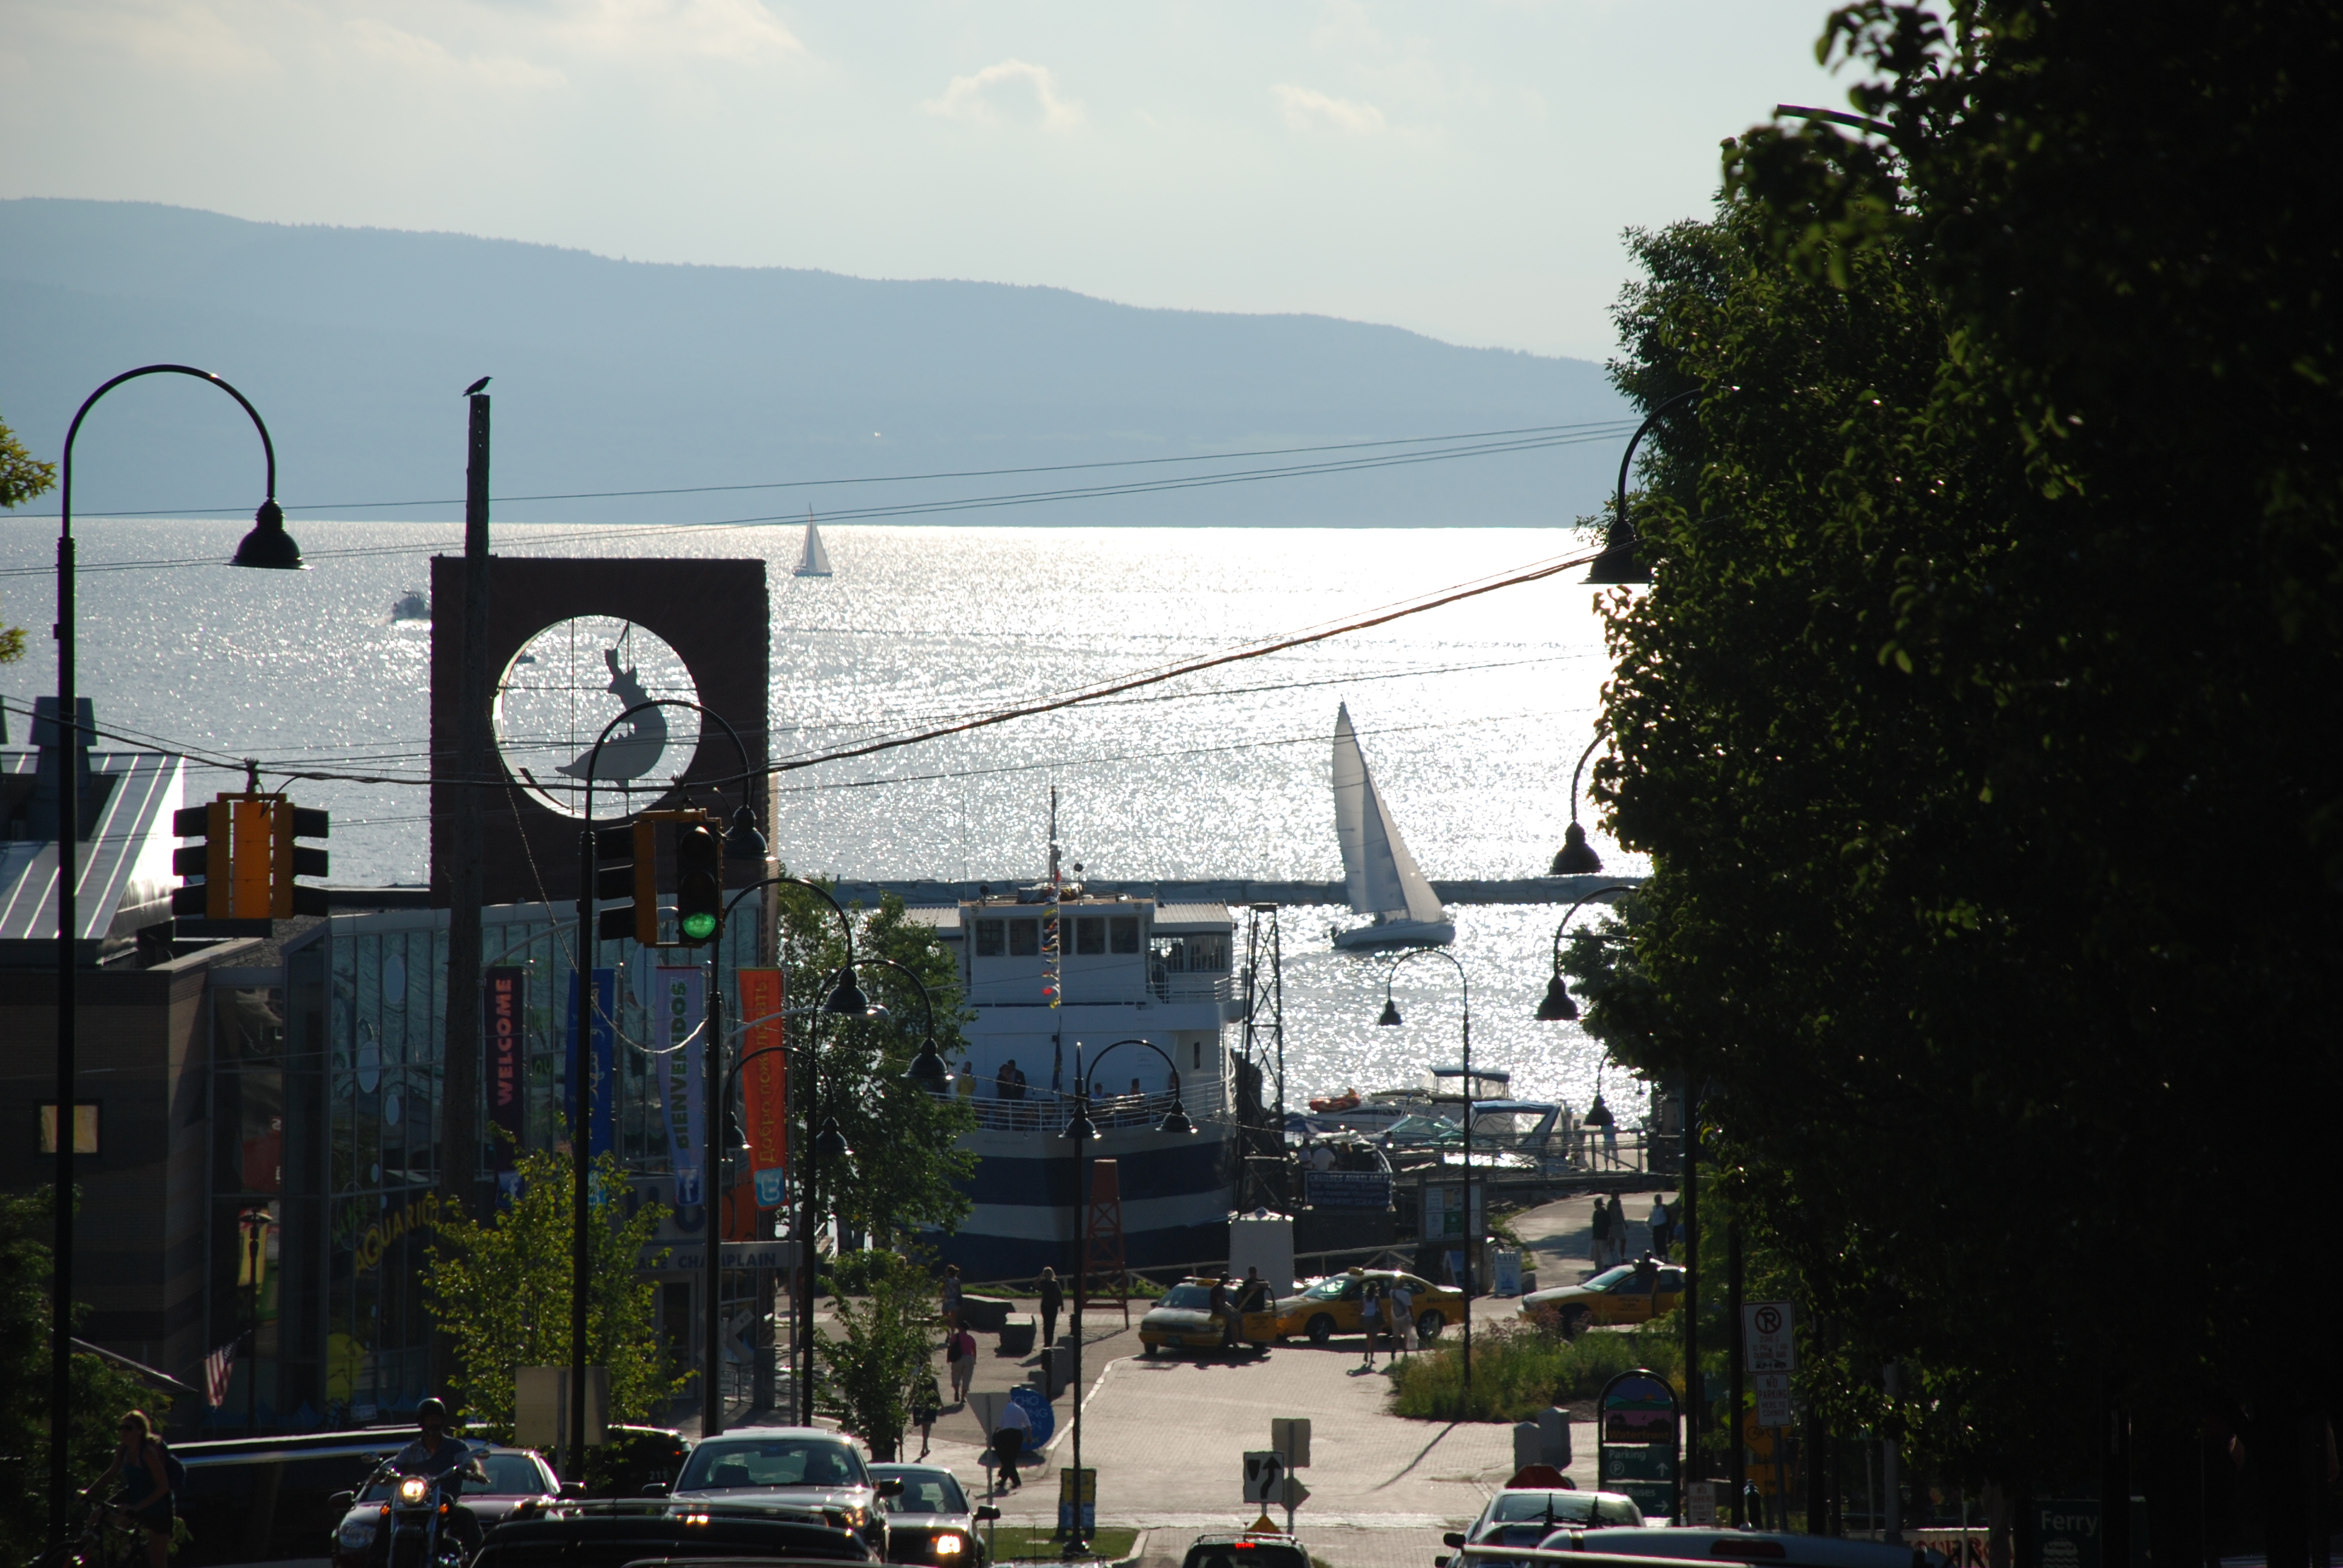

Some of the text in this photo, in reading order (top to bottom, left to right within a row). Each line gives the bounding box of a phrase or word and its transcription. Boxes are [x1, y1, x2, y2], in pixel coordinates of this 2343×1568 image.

[496, 978, 513, 1106] WELCOME
[670, 982, 690, 1149] BIENVENIDOS
[759, 1101, 777, 1163] Добро
[356, 1199, 441, 1278] AQUARIU
[1766, 1378, 1778, 1388] NO
[1758, 1390, 1787, 1399] PARKING
[1608, 1430, 1670, 1439] Waterfront
[1609, 1450, 1647, 1462] Parking
[1627, 1487, 1656, 1497] Buses
[2041, 1509, 2099, 1538] Ferry
